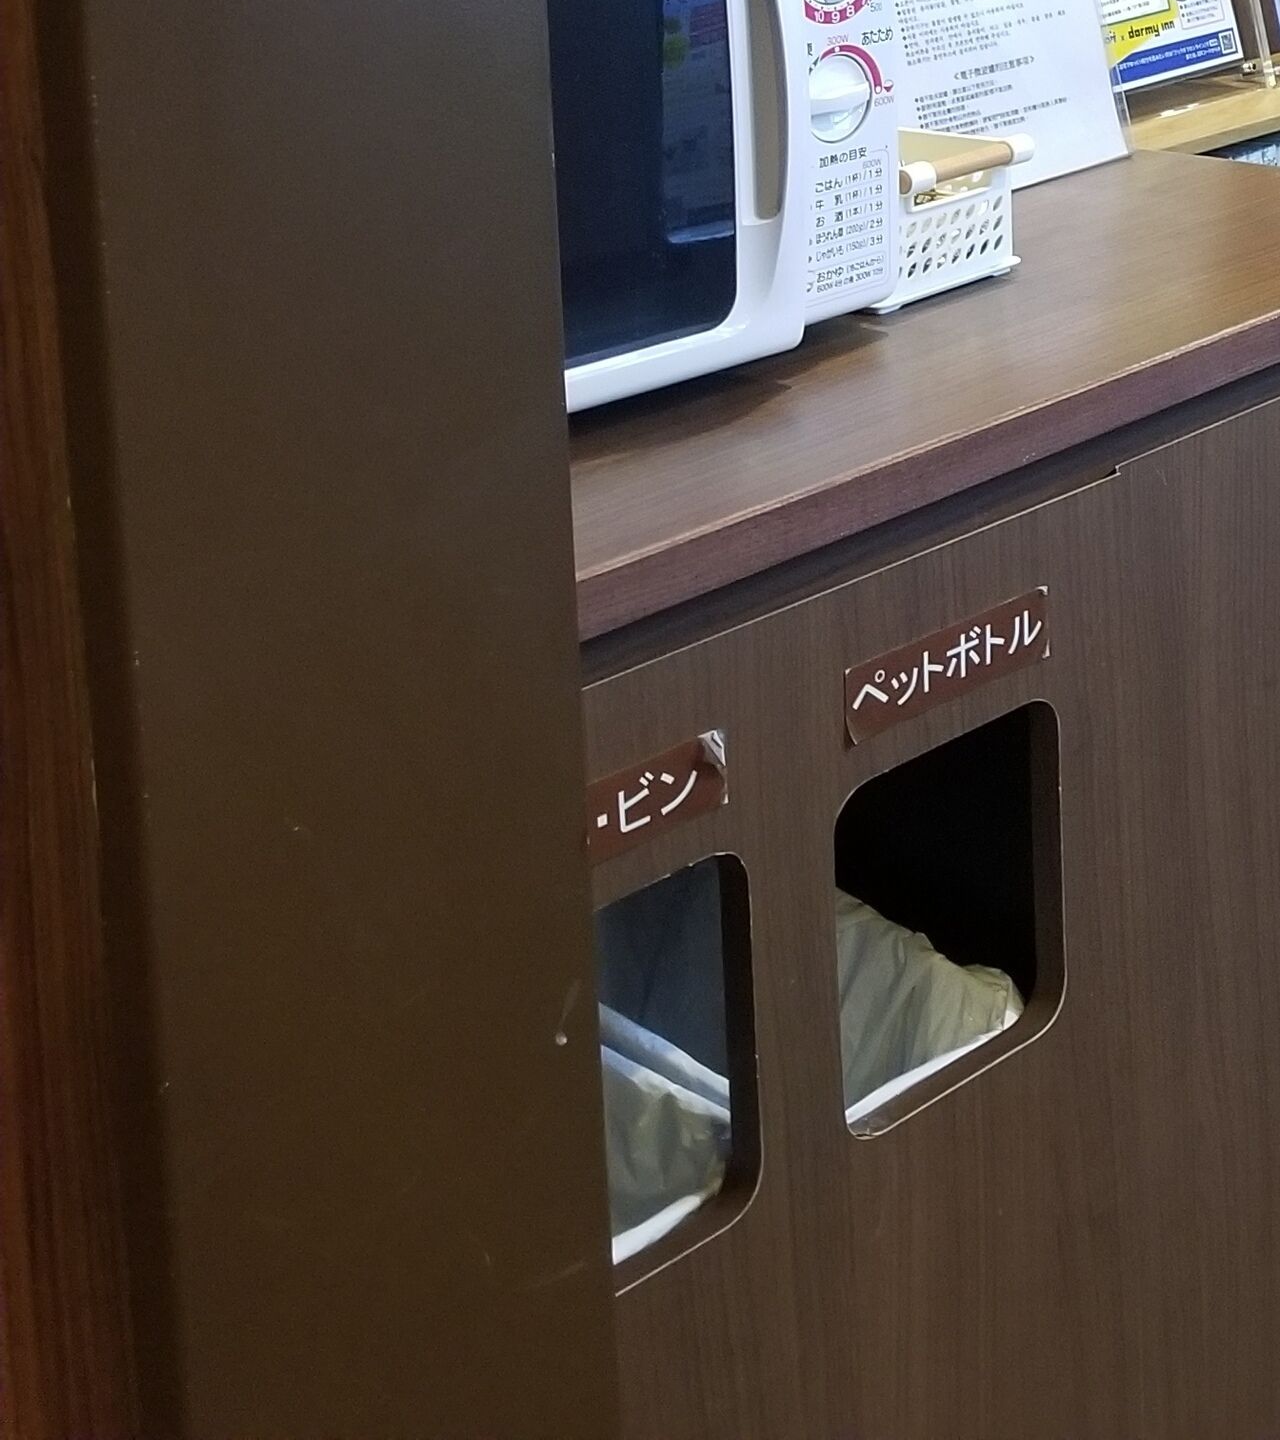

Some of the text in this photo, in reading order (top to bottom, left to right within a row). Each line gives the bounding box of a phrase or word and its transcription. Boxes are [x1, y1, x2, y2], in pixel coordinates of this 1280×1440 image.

[814, 10, 824, 23] 10
[831, 11, 840, 23] 9
[846, 5, 855, 18] 8
[861, 28, 893, 46] あたため
[1128, 23, 1160, 40] dormy
[819, 147, 867, 169] 加熱の目安
[851, 610, 1042, 711] ペットボトル
